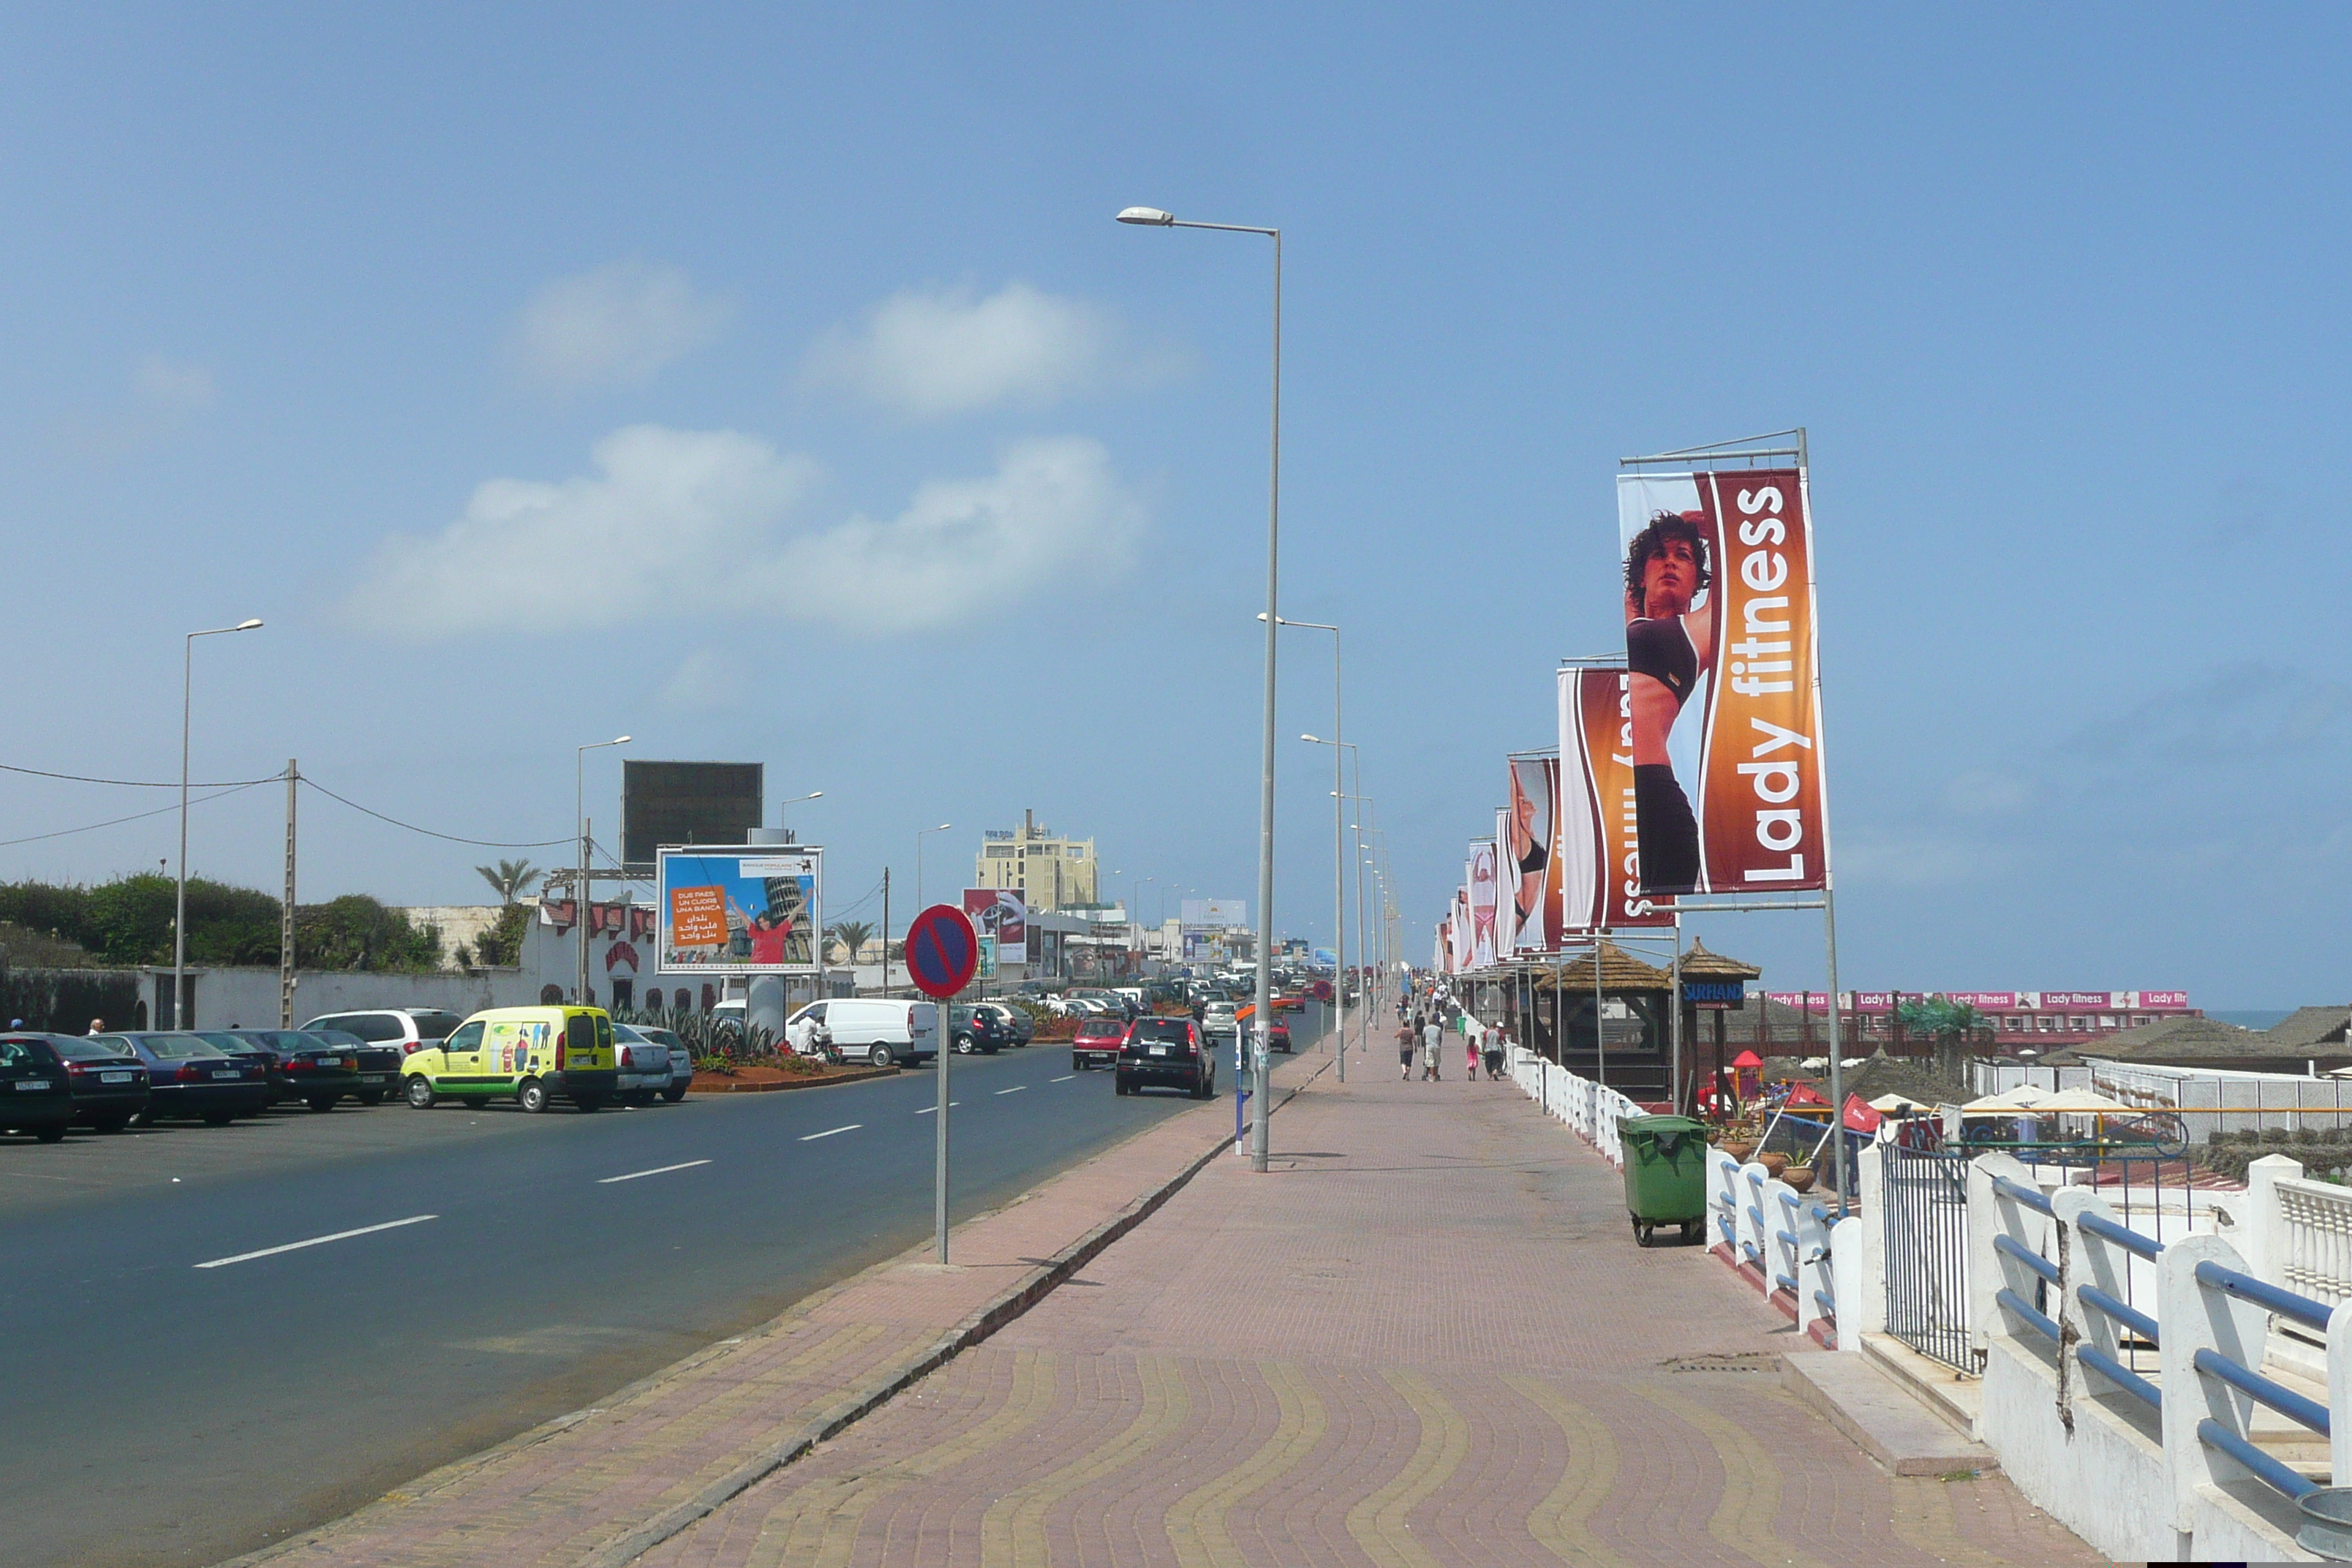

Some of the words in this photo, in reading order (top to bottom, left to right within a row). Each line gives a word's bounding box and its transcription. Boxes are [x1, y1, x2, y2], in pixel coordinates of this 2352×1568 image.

[1731, 486, 1793, 697] fitness
[1737, 717, 1812, 882] Lady
[1684, 983, 1743, 1001] SURFLAND
[1861, 994, 1884, 1006] Lady
[1978, 994, 2008, 1004] fitness
[2047, 994, 2070, 1006] Lady
[2072, 994, 2102, 1004] fitness
[2149, 993, 2172, 1004] Lady
